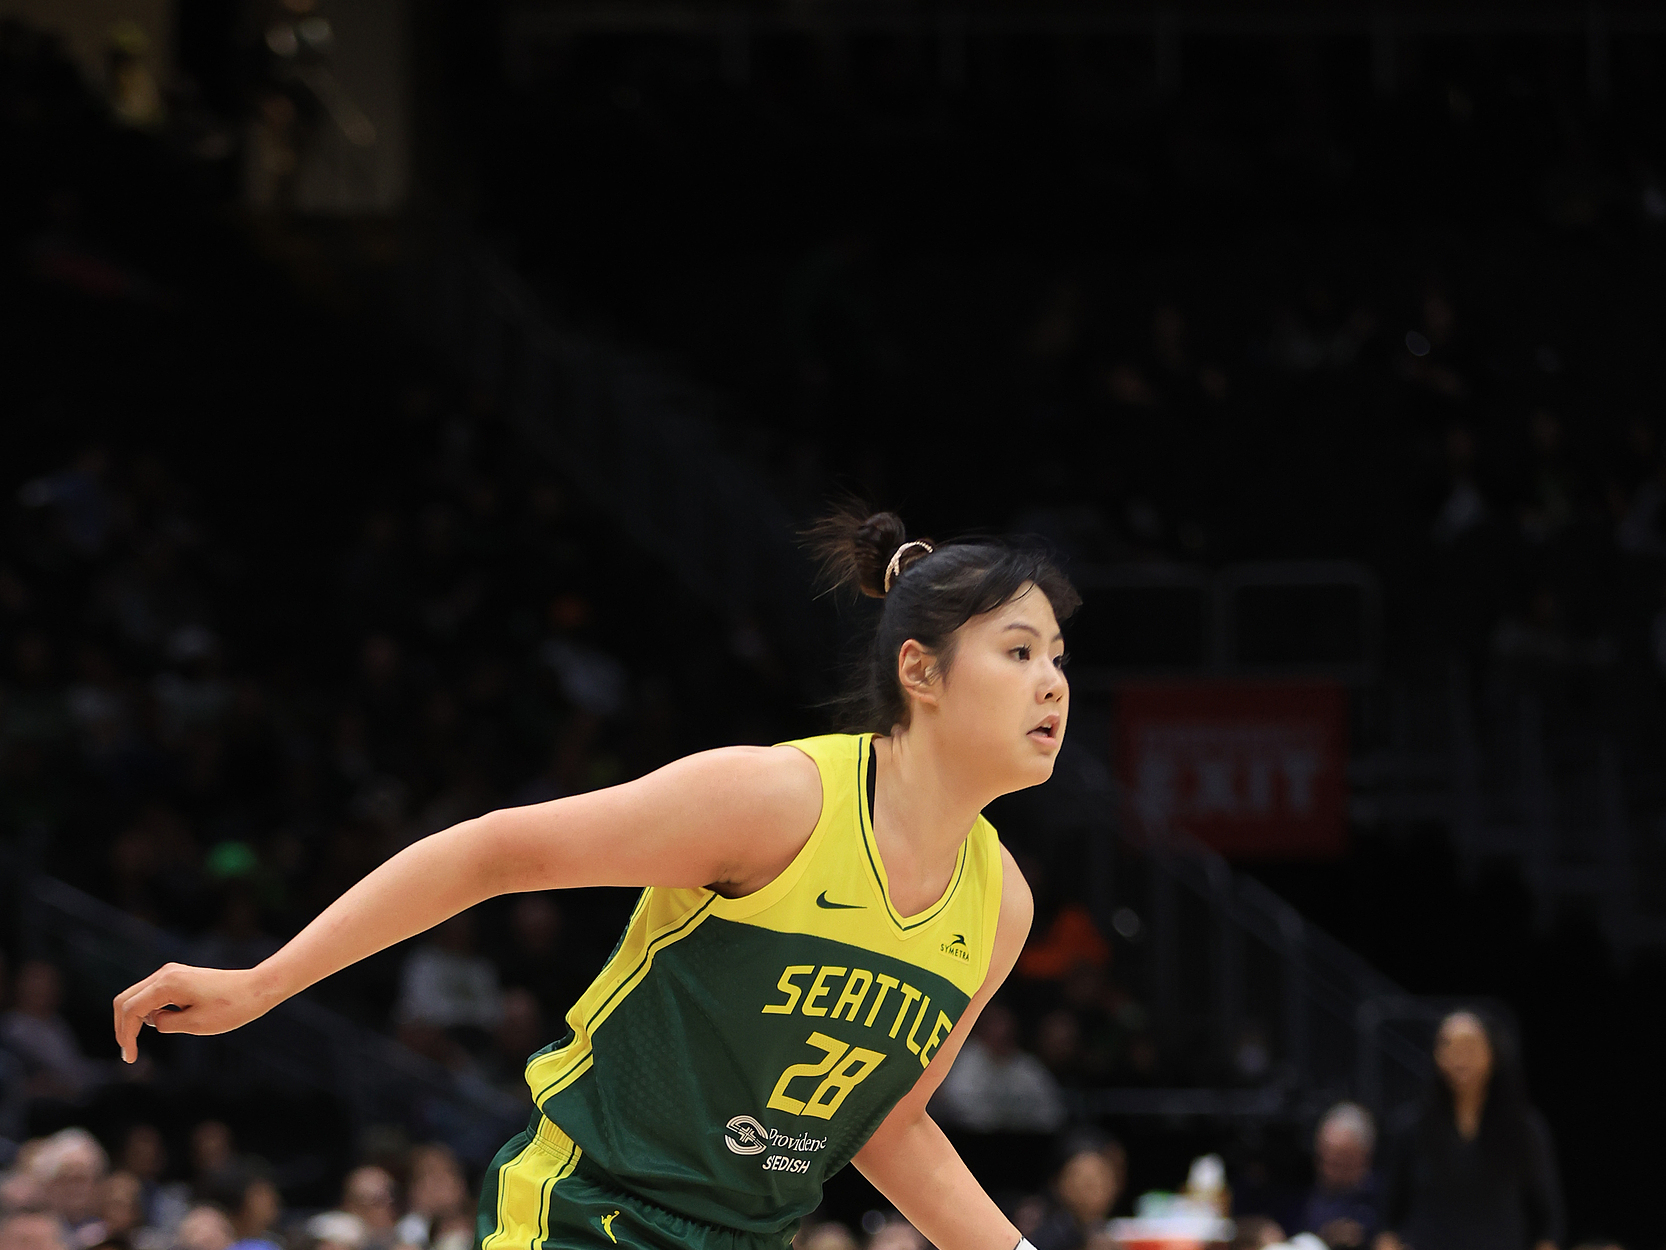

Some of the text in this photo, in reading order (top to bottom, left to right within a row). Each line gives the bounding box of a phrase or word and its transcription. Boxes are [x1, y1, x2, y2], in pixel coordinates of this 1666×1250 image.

[1136, 752, 1317, 817] EXIT
[940, 943, 970, 961] SYMETRA
[761, 965, 954, 1068] SEATTLE
[767, 1032, 886, 1120] 28
[769, 1128, 828, 1152] Providenc
[761, 1154, 811, 1174] SEDISH
